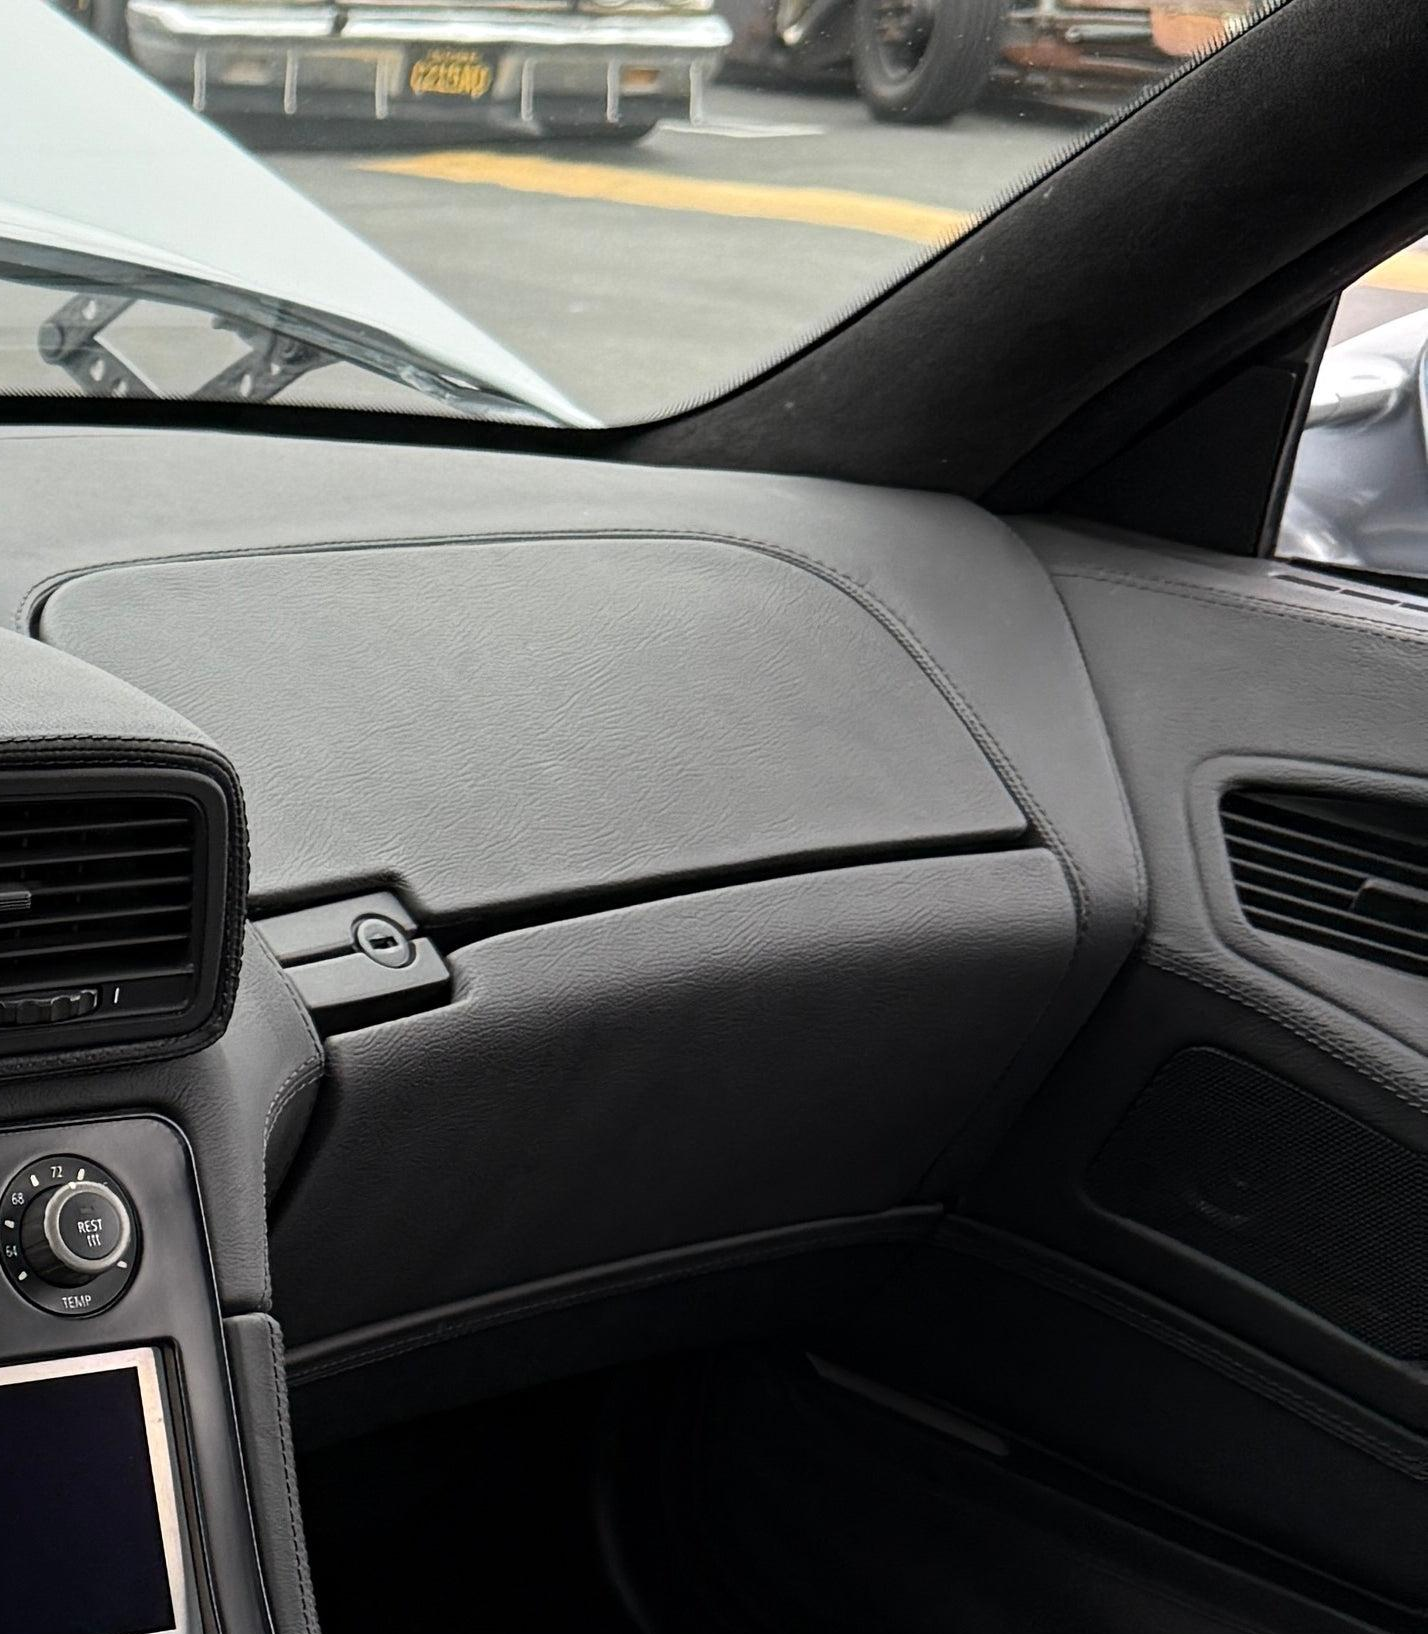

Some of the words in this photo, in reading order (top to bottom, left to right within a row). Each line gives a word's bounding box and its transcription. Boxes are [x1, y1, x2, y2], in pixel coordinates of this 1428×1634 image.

[51, 1166, 63, 1178] 72
[12, 1193, 24, 1205] 68
[78, 1218, 102, 1233] REST
[62, 1295, 92, 1309] TEMP
